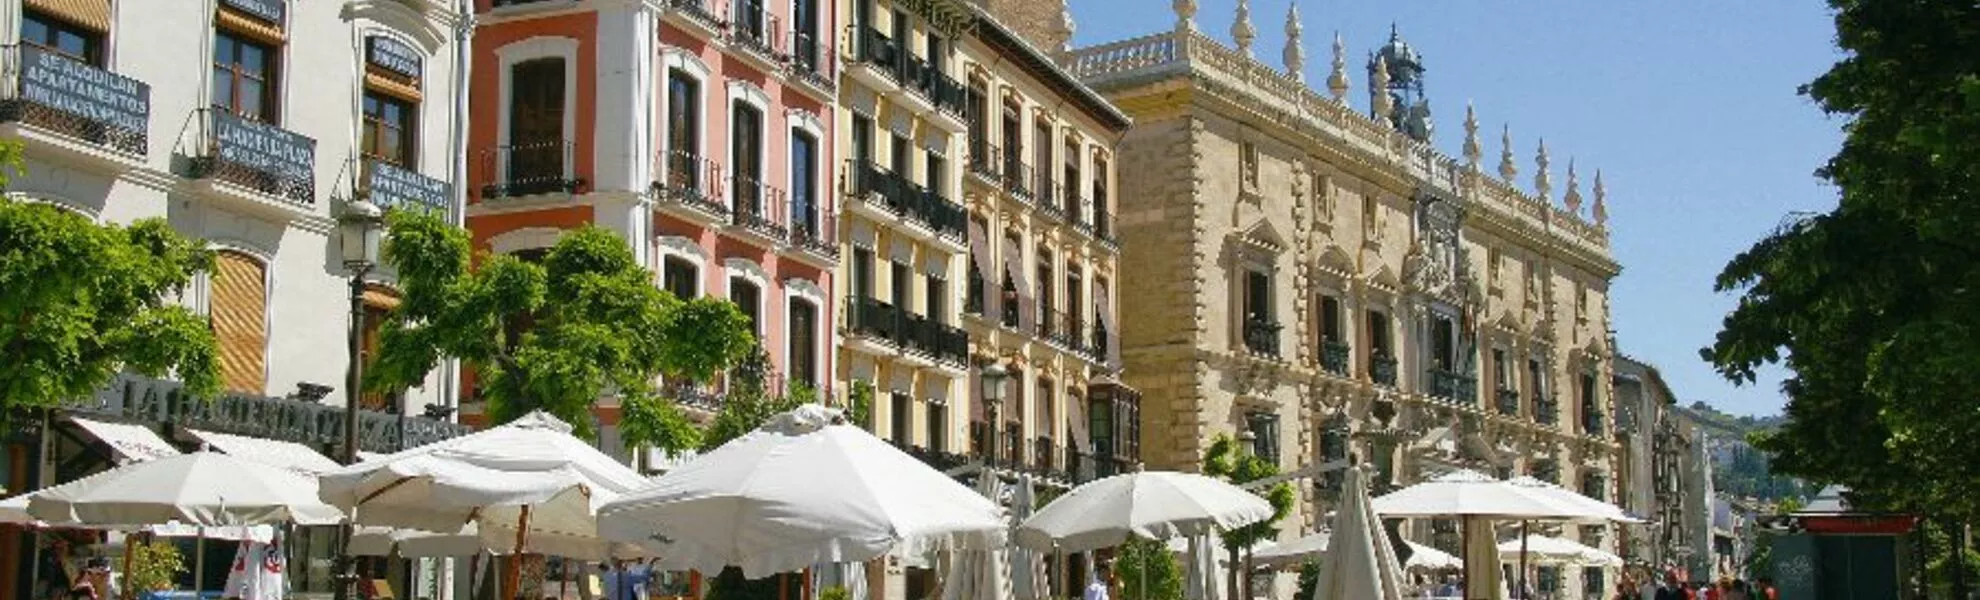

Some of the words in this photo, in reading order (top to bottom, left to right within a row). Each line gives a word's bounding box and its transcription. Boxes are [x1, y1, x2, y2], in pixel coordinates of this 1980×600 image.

[26, 66, 146, 114] APARTAMENTOS
[40, 53, 61, 70] SE
[63, 59, 138, 95] ALQUILAN
